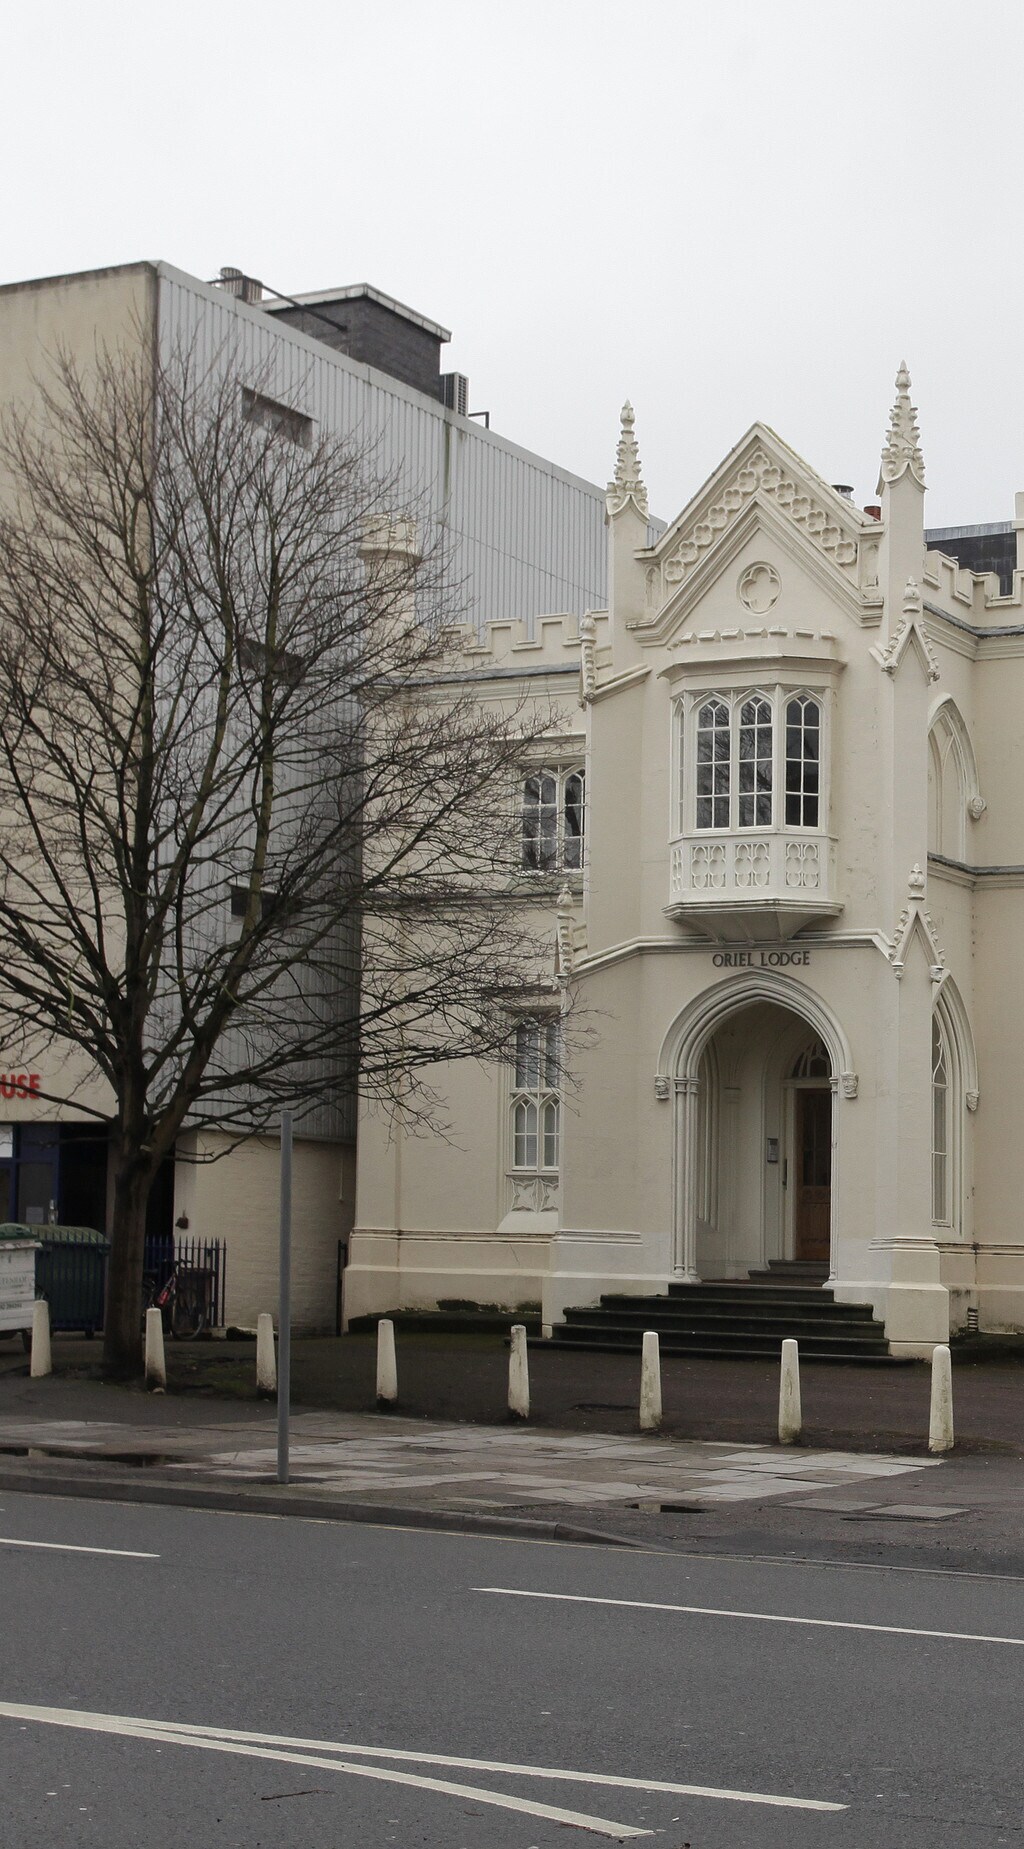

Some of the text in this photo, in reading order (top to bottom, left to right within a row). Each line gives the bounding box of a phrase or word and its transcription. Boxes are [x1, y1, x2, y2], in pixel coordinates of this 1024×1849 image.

[712, 950, 811, 968] ORIEL LODGE
[0, 1073, 41, 1100] USE
